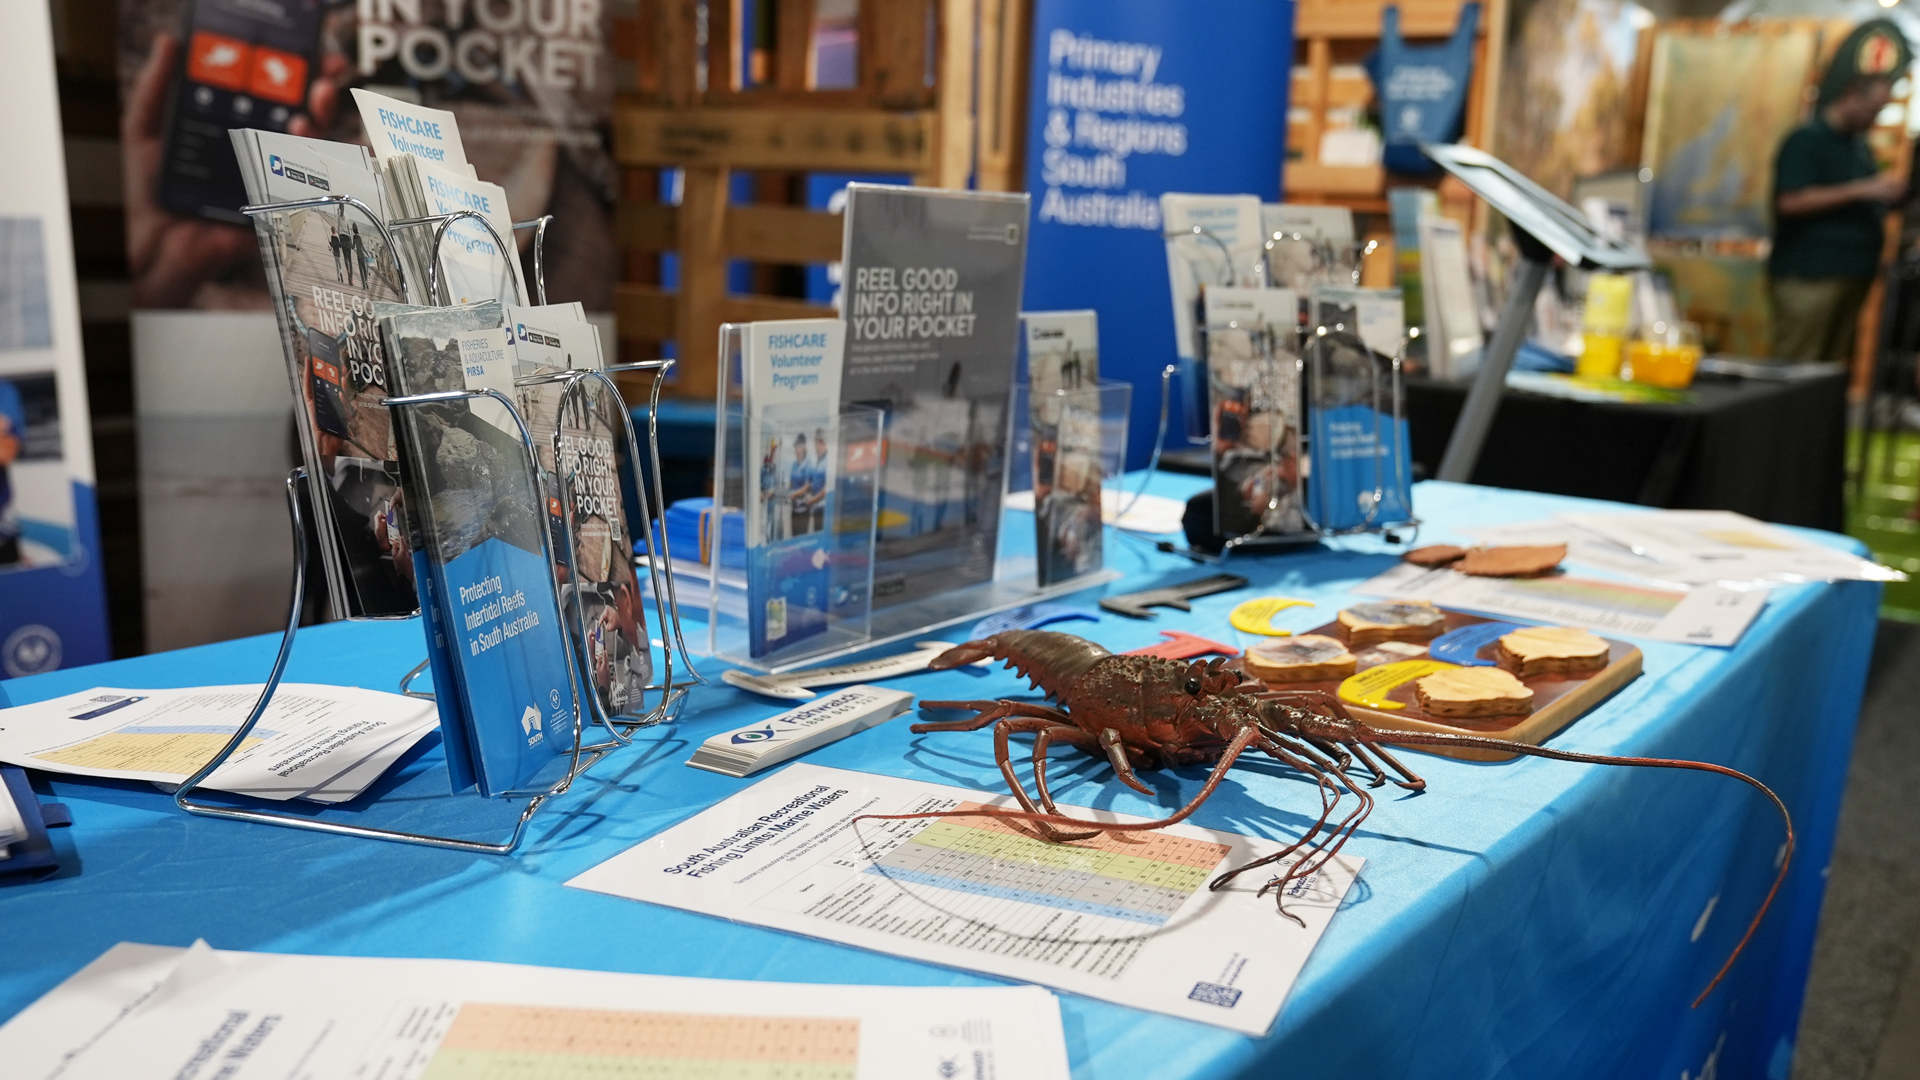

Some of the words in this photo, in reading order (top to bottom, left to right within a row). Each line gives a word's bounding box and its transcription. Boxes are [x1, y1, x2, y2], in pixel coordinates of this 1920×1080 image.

[359, 24, 602, 90] POCKET
[1049, 28, 1163, 84] Primary
[1047, 71, 1186, 118] Industries
[378, 108, 442, 140] FISHCARE
[1044, 109, 1072, 148] &
[1074, 112, 1188, 158] Regions
[388, 132, 445, 162] Volunteer
[1042, 147, 1127, 190] South
[427, 175, 491, 214] FISHCARE
[1039, 187, 1161, 230] Australia
[447, 227, 495, 255] Program
[855, 267, 900, 292] REEL
[902, 267, 959, 291] GOOD
[312, 285, 351, 314] REEL
[351, 295, 375, 320] GO
[853, 293, 900, 316] INFO
[902, 292, 953, 315] RIGHT
[955, 292, 974, 314] IN
[318, 310, 356, 337] INFO
[853, 316, 905, 341] YOUR
[906, 315, 977, 339] POCKET
[346, 337, 363, 361] IN
[363, 341, 382, 364] YO
[462, 338, 488, 351] FISHERIES
[768, 333, 827, 350] FISHCARE
[469, 349, 505, 363] AQUACULTURE
[770, 353, 823, 369] Volunteer
[350, 360, 385, 386] POC
[466, 365, 485, 377] PIRSA
[772, 372, 819, 389] Program
[579, 437, 611, 458] GOOD
[583, 457, 613, 477] RIGHT
[574, 475, 586, 495] IN
[587, 477, 616, 497] YOUR
[577, 495, 617, 515] POCKET
[459, 575, 503, 606] Protecting
[464, 599, 501, 632] Intertidal
[501, 590, 526, 614] Reefs
[470, 638, 480, 657] in
[478, 625, 503, 652] South
[502, 610, 540, 642] Australia
[779, 692, 865, 725] Fishwatch
[801, 715, 832, 728] 1800
[663, 850, 711, 875] South
[703, 822, 768, 855] Australian
[757, 784, 831, 824] Recreational
[686, 852, 744, 879] Fishing
[730, 831, 779, 855] Limits:
[768, 810, 814, 833] Marine
[804, 788, 849, 810] Waters
